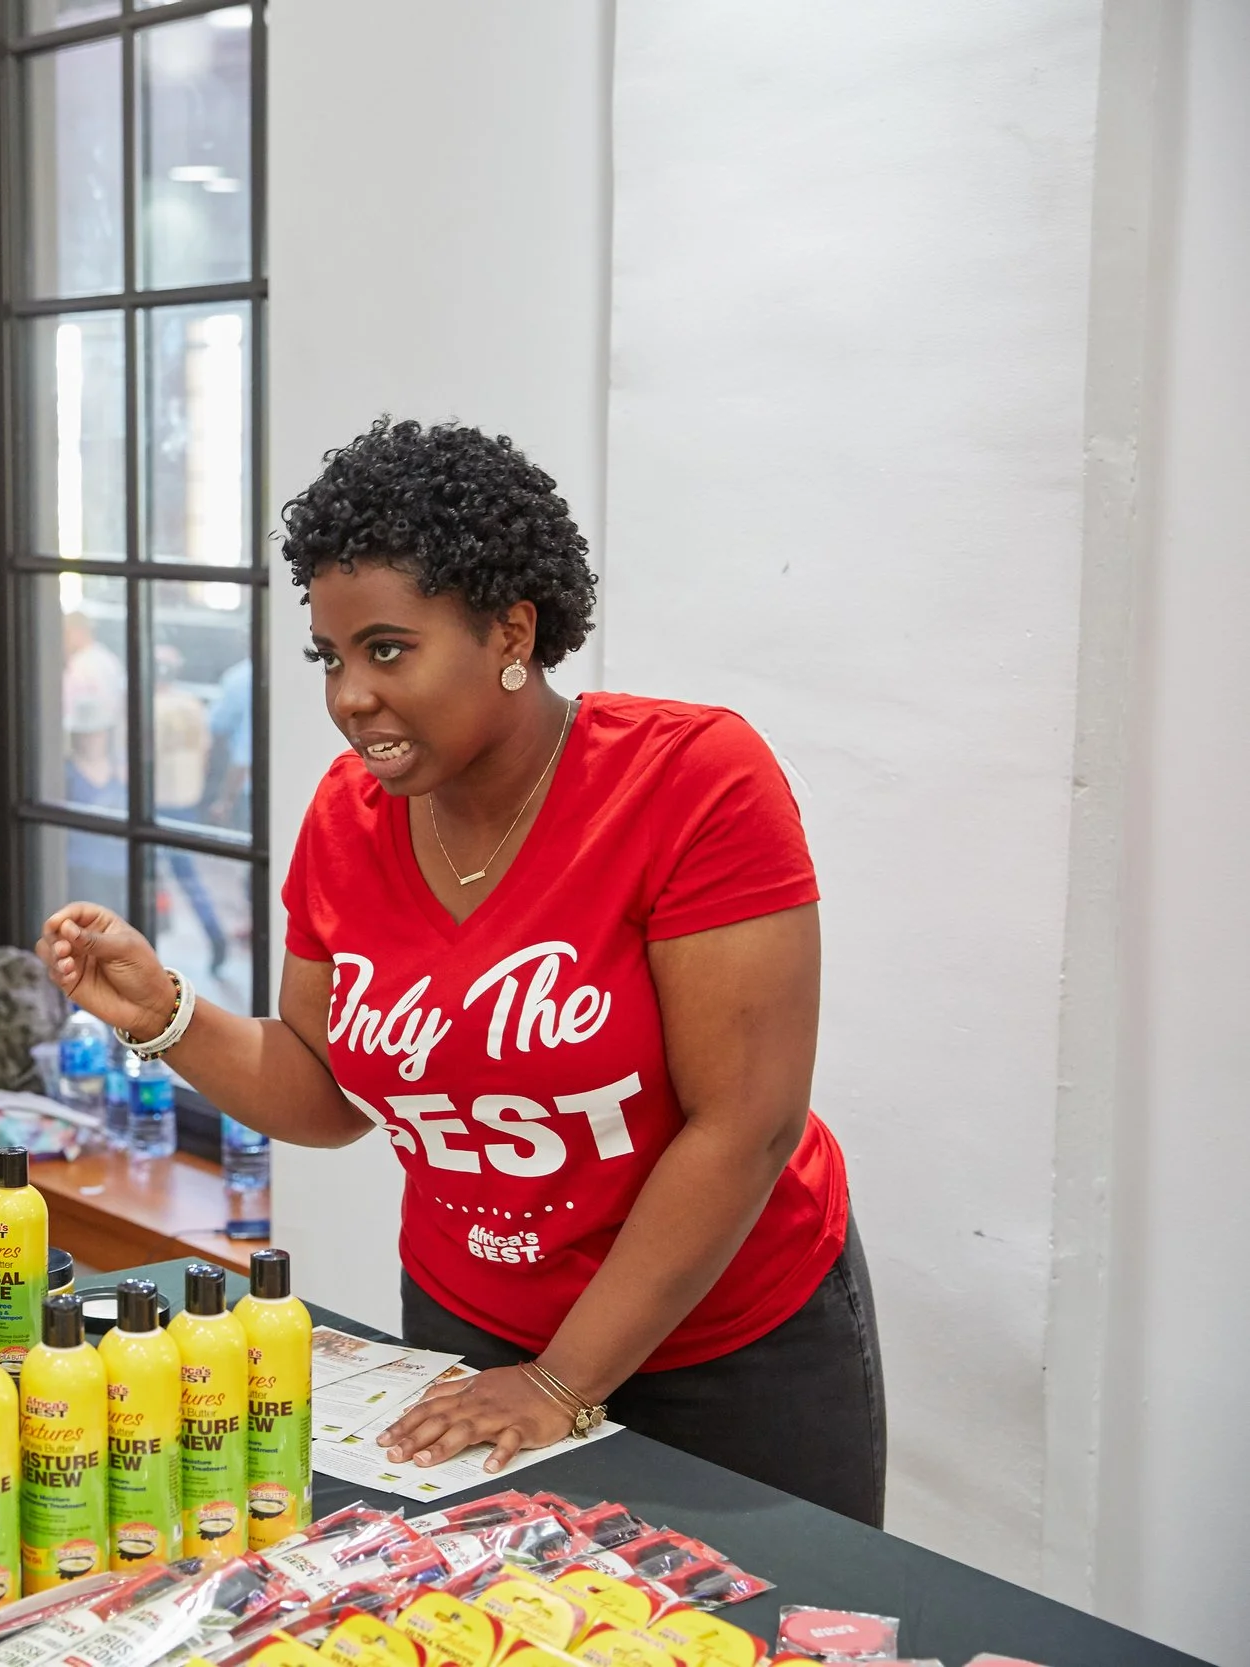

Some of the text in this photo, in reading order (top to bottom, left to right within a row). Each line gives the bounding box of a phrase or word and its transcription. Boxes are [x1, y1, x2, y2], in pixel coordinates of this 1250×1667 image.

[327, 940, 611, 1081] Only The
[468, 1224, 539, 1247] Africa's
[181, 1366, 211, 1376] rica's
[181, 1375, 211, 1384] EST
[181, 1388, 225, 1407] tures
[108, 1410, 144, 1427] ures
[187, 1407, 218, 1419] Butter
[182, 1415, 240, 1436] TURE
[109, 1437, 162, 1456] TURE
[182, 1435, 224, 1451] NEW
[100, 1632, 134, 1656] BRUS
